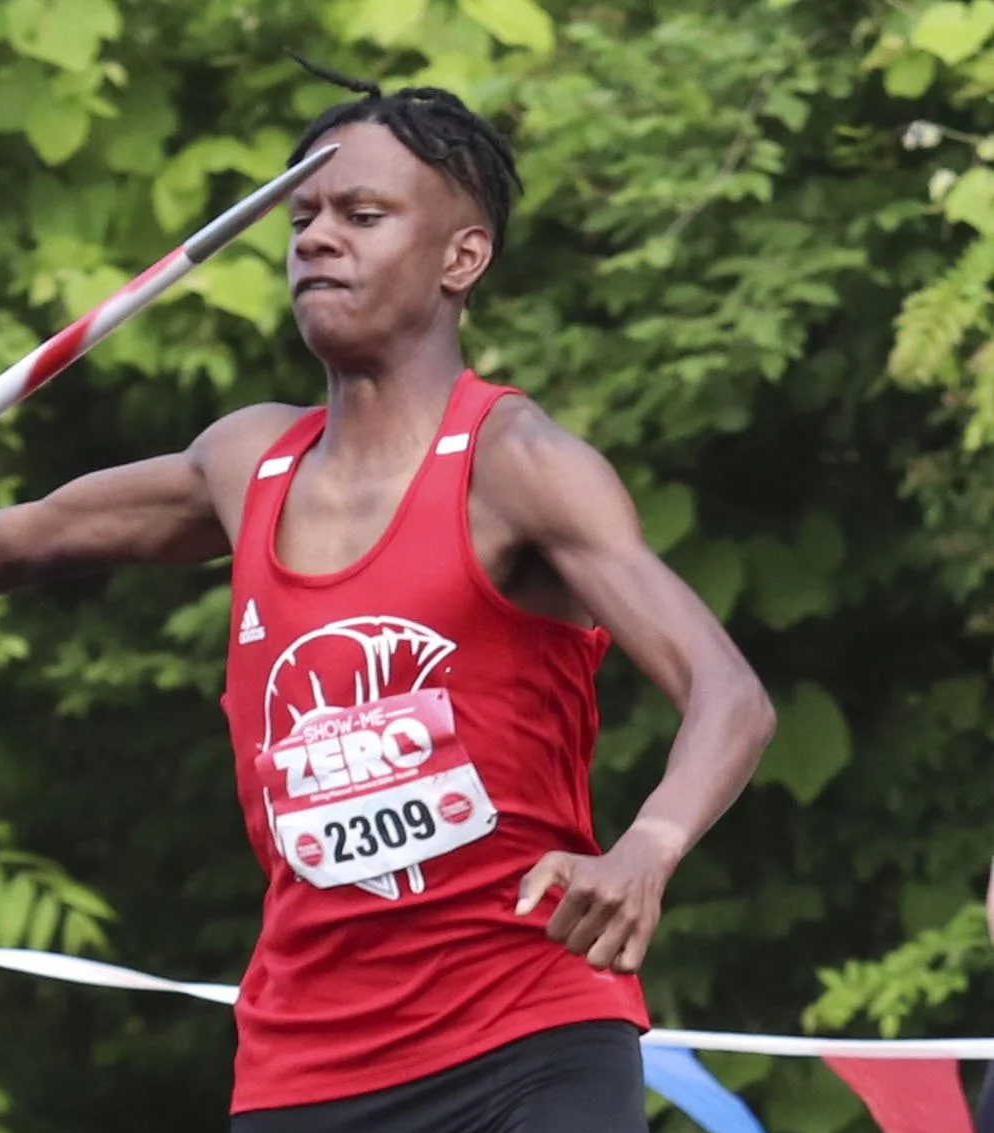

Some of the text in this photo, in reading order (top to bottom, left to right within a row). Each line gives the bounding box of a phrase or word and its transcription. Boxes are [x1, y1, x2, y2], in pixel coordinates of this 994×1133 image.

[303, 707, 386, 744] SHOW-ME
[273, 717, 433, 799] ZERO
[324, 799, 436, 863] 2309
